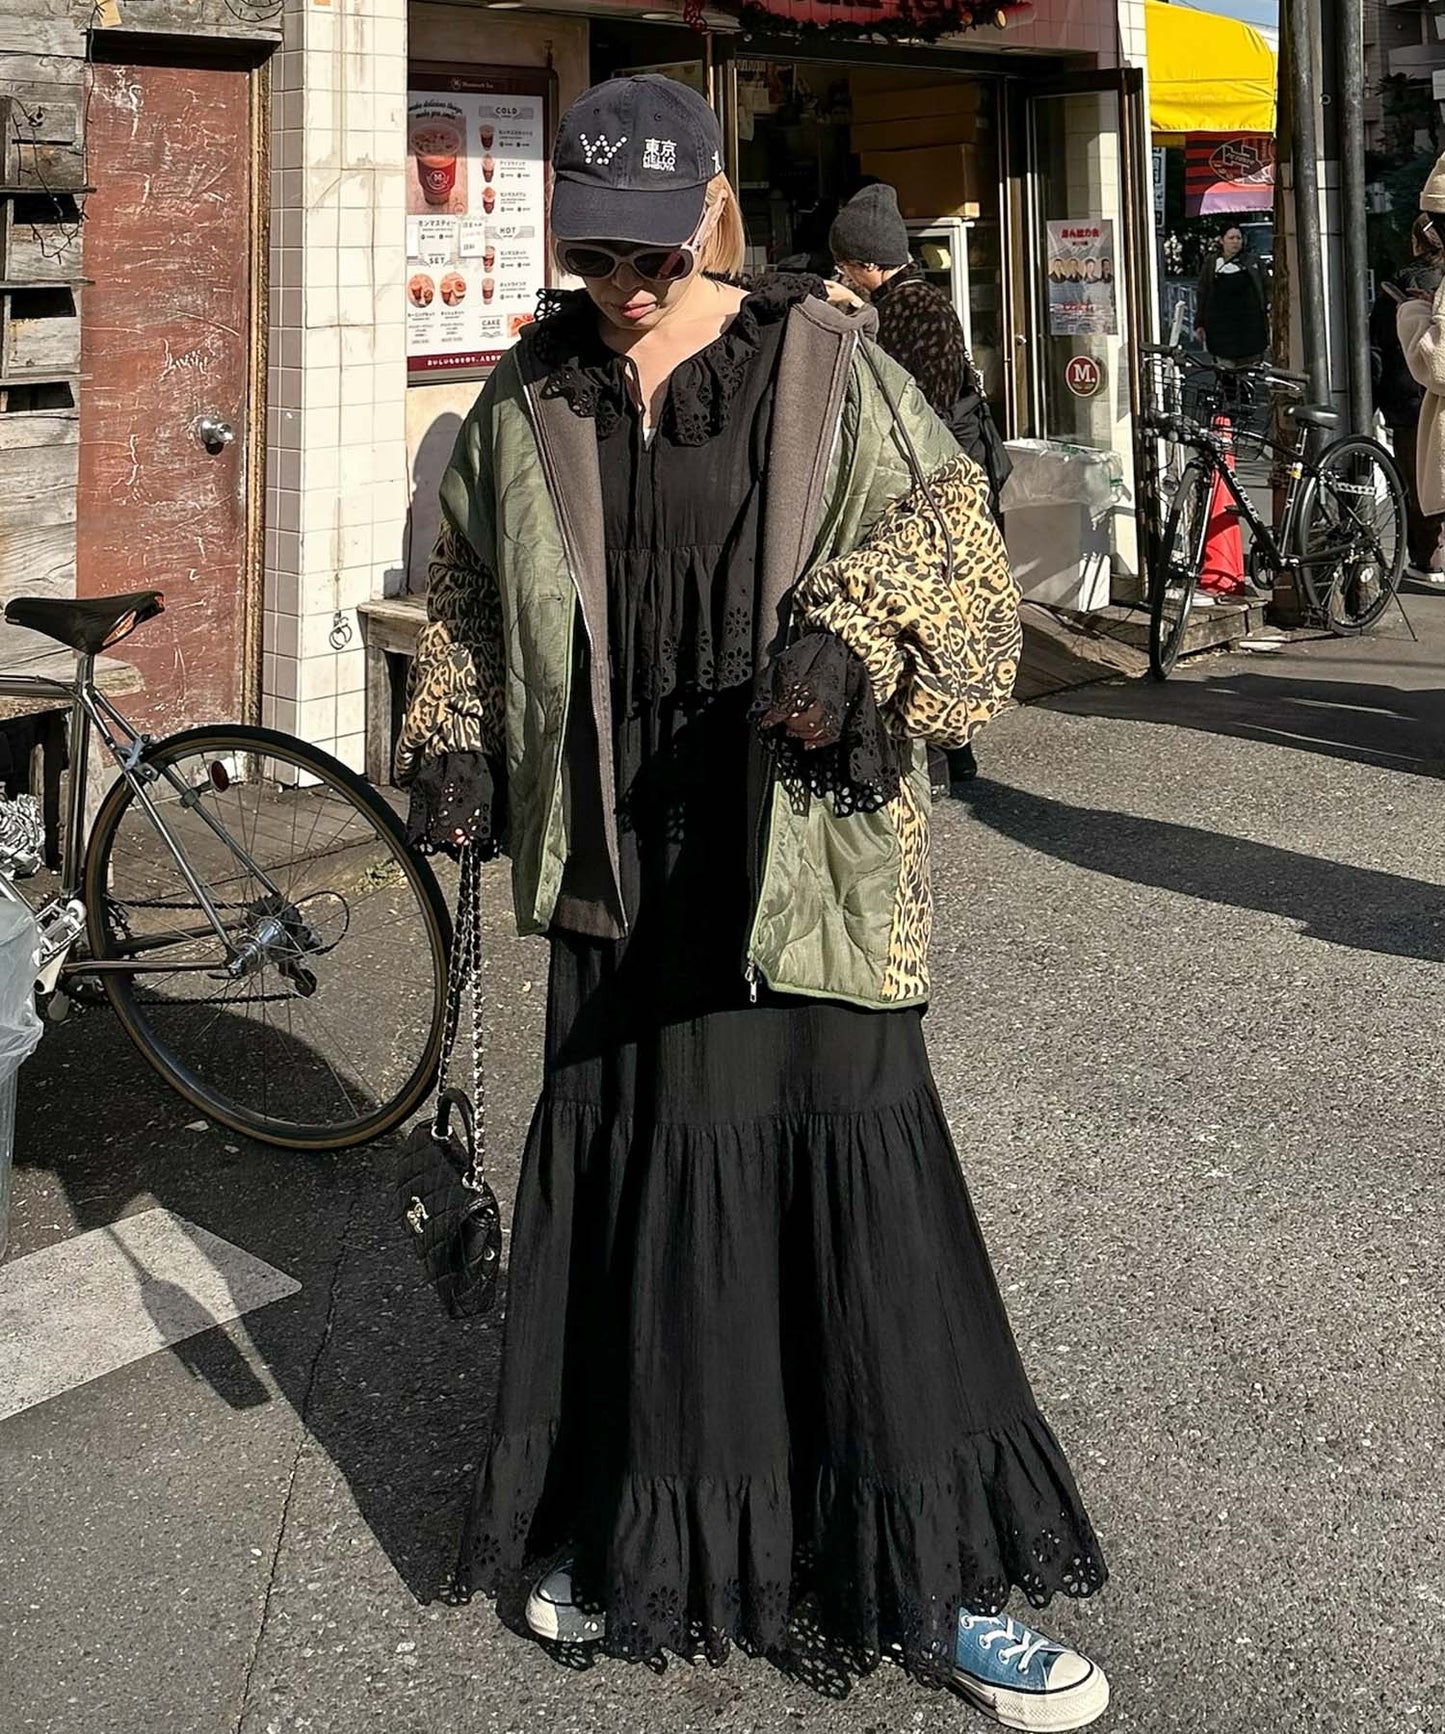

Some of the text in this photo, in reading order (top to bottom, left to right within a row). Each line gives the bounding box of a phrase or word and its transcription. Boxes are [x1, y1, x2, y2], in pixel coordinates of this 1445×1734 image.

[495, 106, 518, 115] COLD
[579, 133, 628, 165] W
[644, 138, 677, 158] 東京
[643, 154, 676, 165] HELLO
[418, 219, 456, 227] モンマスティー
[499, 226, 517, 234] HOT
[428, 257, 445, 265] SET
